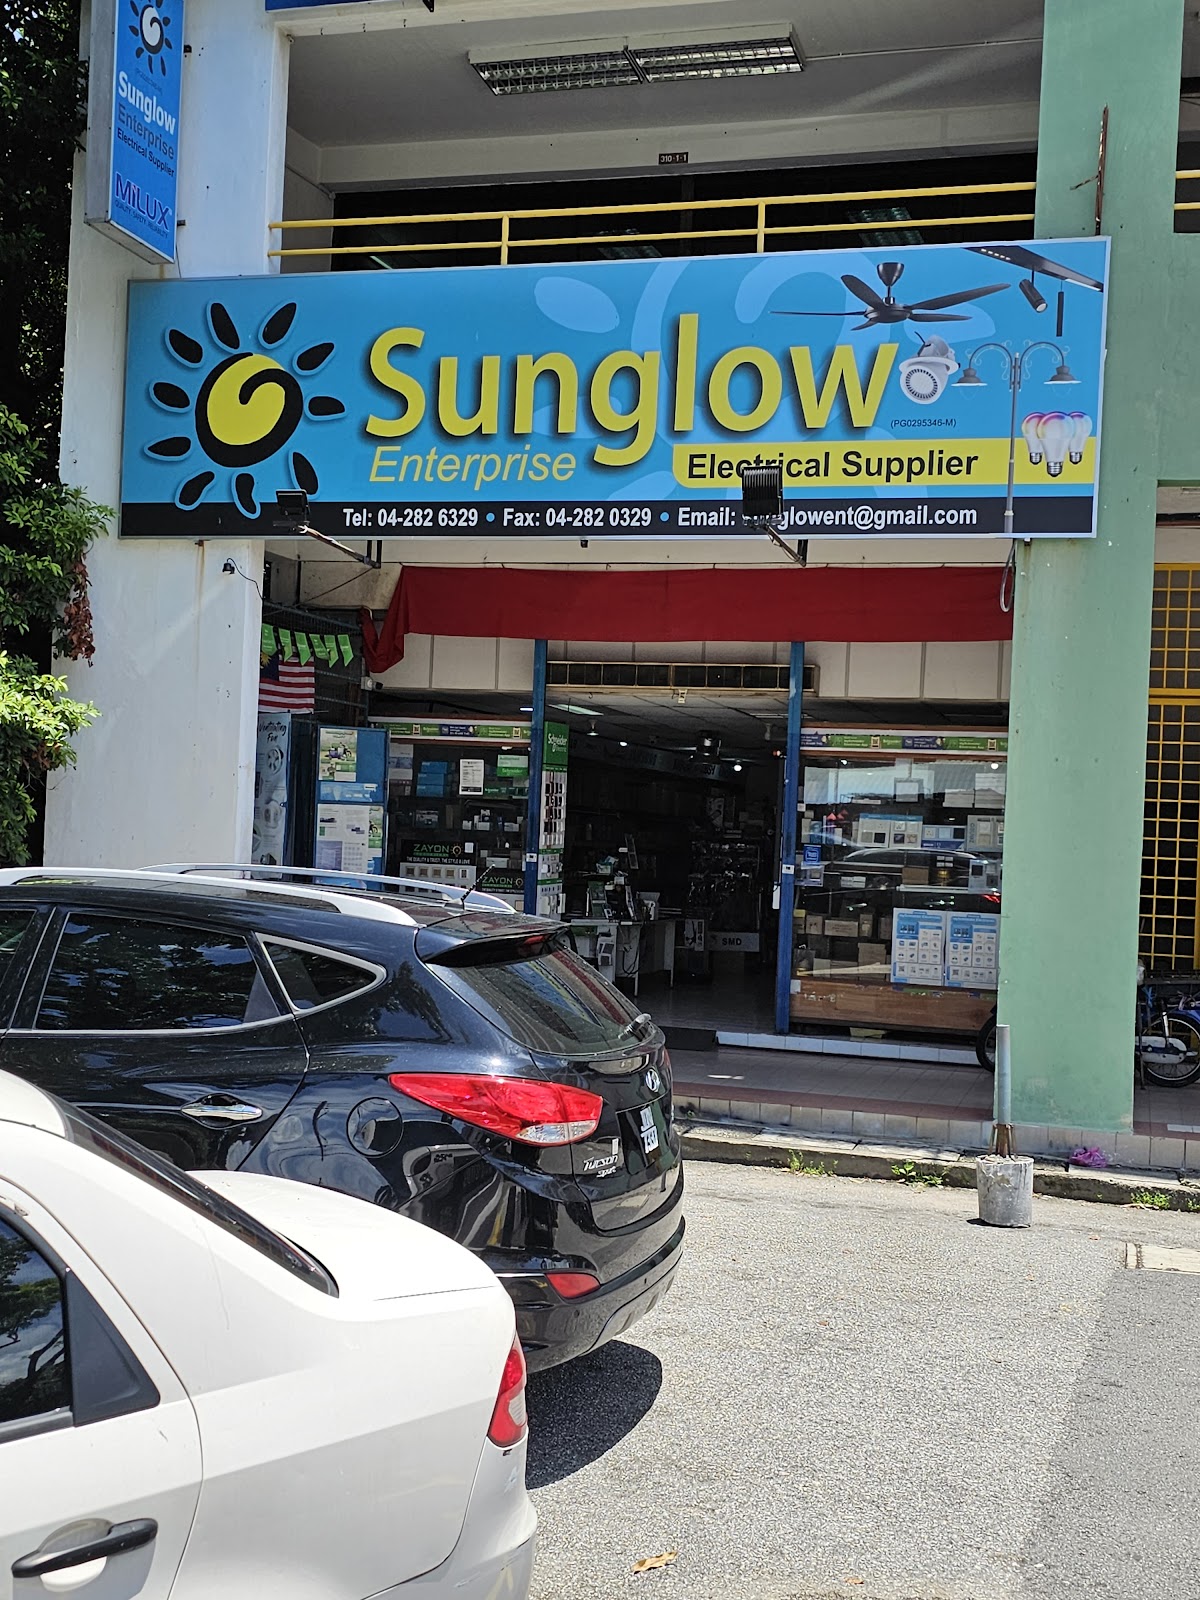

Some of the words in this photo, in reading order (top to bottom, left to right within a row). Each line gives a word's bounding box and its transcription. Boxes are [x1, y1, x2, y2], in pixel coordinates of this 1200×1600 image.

[118, 70, 176, 136] Sunglow
[118, 103, 175, 160] Enterprise
[117, 127, 147, 160] Electrical
[148, 151, 175, 178] Supplier
[366, 313, 899, 467] Sunglow
[890, 419, 957, 429] (PG0295346-M)
[369, 444, 577, 491] Enterprise
[841, 449, 979, 483] Supplier
[343, 508, 373, 527] Tel:
[377, 508, 434, 527] 04-282
[437, 507, 479, 527] 6329
[503, 508, 540, 527] Fax:
[545, 507, 604, 527] 04-282
[606, 507, 651, 527] 0329
[678, 506, 736, 526] Email:
[742, 505, 978, 530] glowent@gmail.com
[413, 844, 450, 853] ZAYON
[482, 876, 513, 885] ZAYON
[722, 937, 742, 946] SMD
